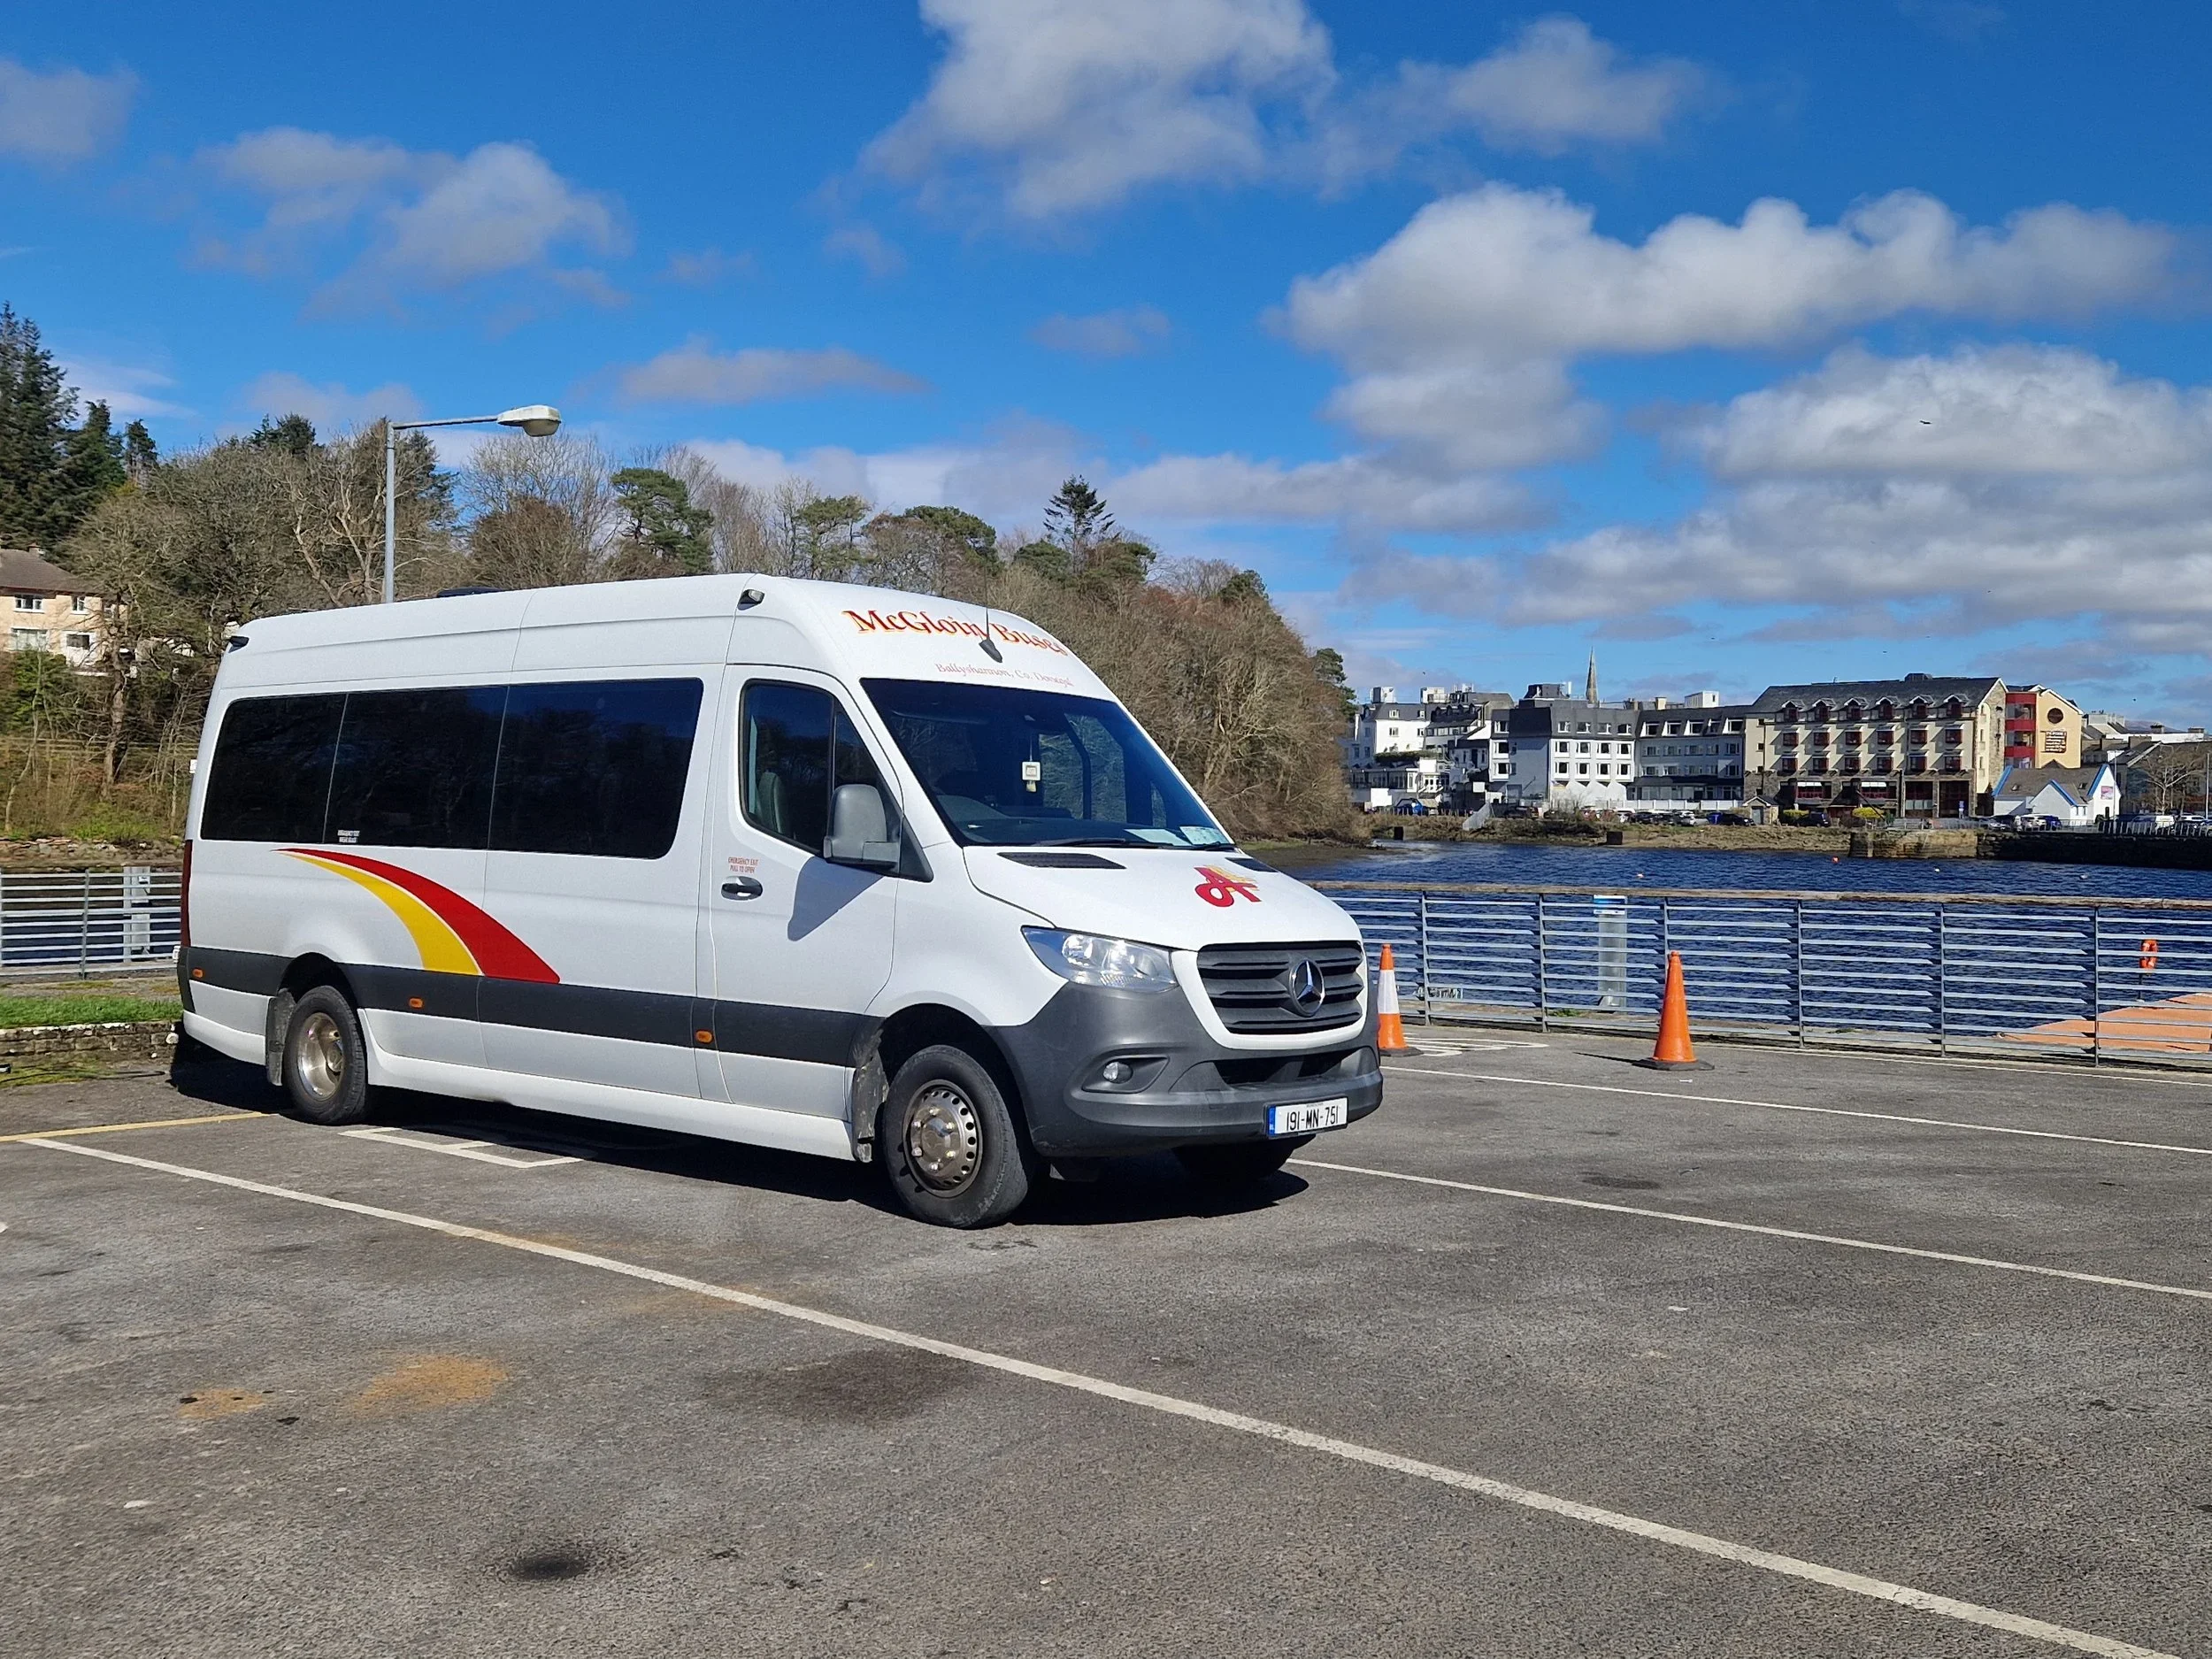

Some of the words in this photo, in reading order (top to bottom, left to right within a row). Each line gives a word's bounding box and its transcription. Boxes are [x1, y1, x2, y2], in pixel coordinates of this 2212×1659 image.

[841, 609, 989, 638] McGloin
[991, 622, 1069, 657] Buses
[1286, 1106, 1339, 1131] 191-MN-751
